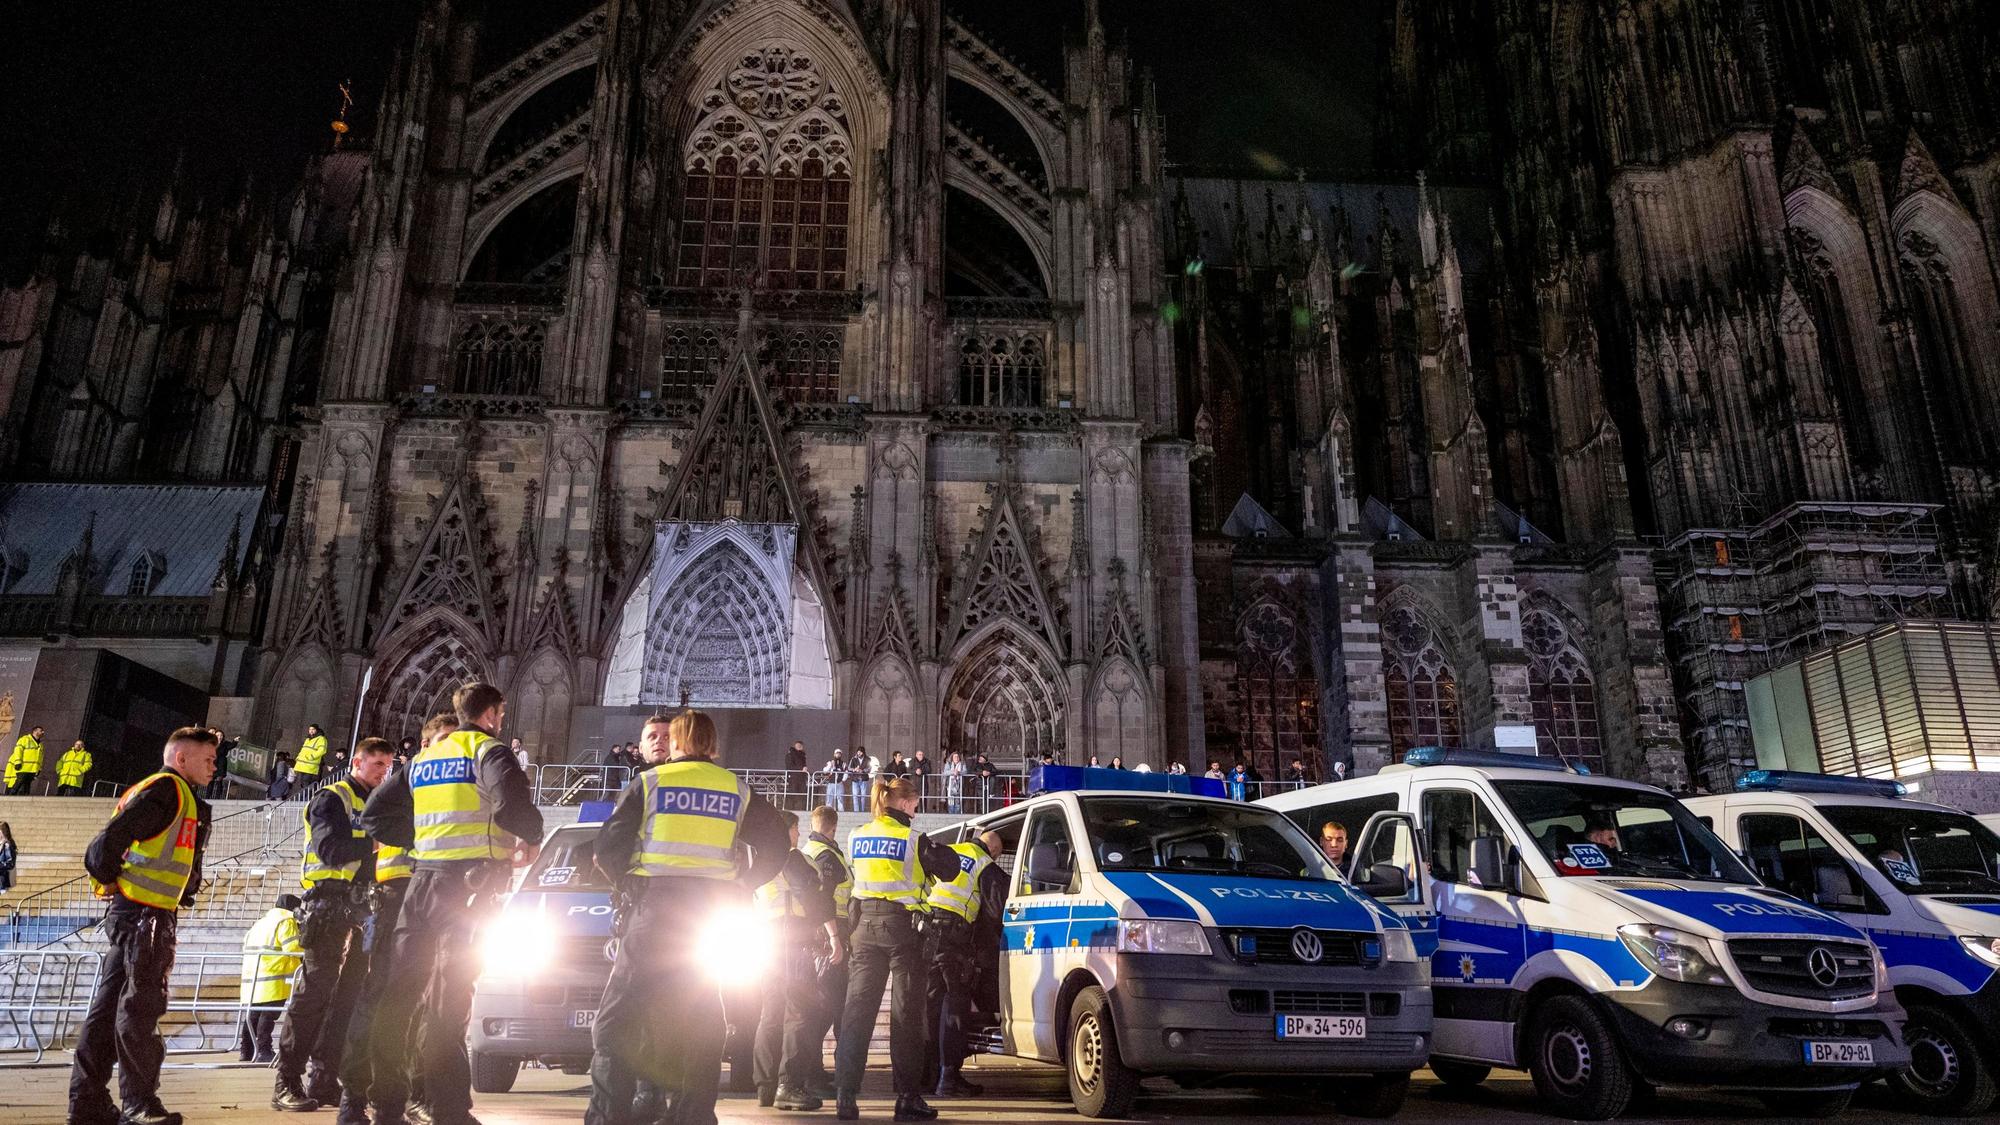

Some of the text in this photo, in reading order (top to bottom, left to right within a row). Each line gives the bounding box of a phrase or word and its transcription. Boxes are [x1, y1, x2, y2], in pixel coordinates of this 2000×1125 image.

[226, 747, 262, 769] gang
[413, 760, 470, 784] POLIZEI
[664, 791, 735, 816] POLIZEI
[854, 839, 902, 857] POLIZEI
[1582, 856, 1605, 865] 224
[1209, 887, 1339, 903] POLIZEI
[576, 1011, 595, 1026] BP
[1286, 1017, 1363, 1036] BP 34-596
[1815, 1044, 1871, 1061] BP 29-81
